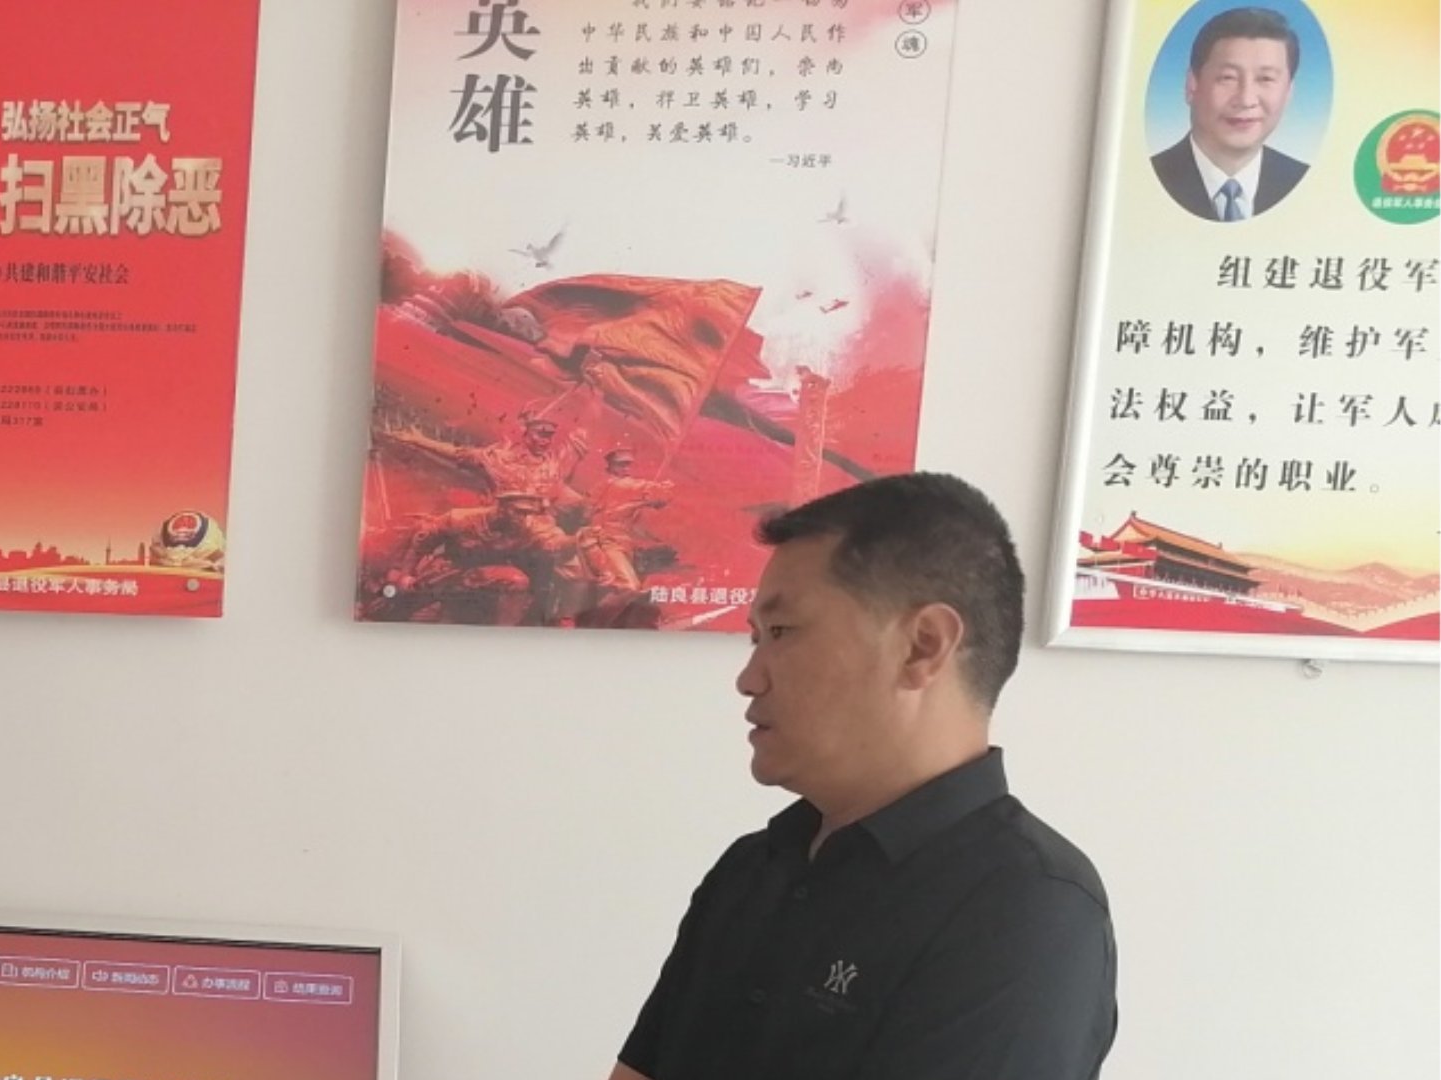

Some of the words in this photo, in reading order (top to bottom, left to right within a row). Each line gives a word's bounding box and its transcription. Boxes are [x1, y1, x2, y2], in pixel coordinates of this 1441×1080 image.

[581, 22, 846, 42] 中华民族和中国人民作
[2, 100, 171, 142] 弘扬社会正气
[0, 154, 223, 236] 扫黑除恶
[1103, 453, 1379, 493] 会尊崇的职业。
[650, 585, 758, 605] 陆良县退役
